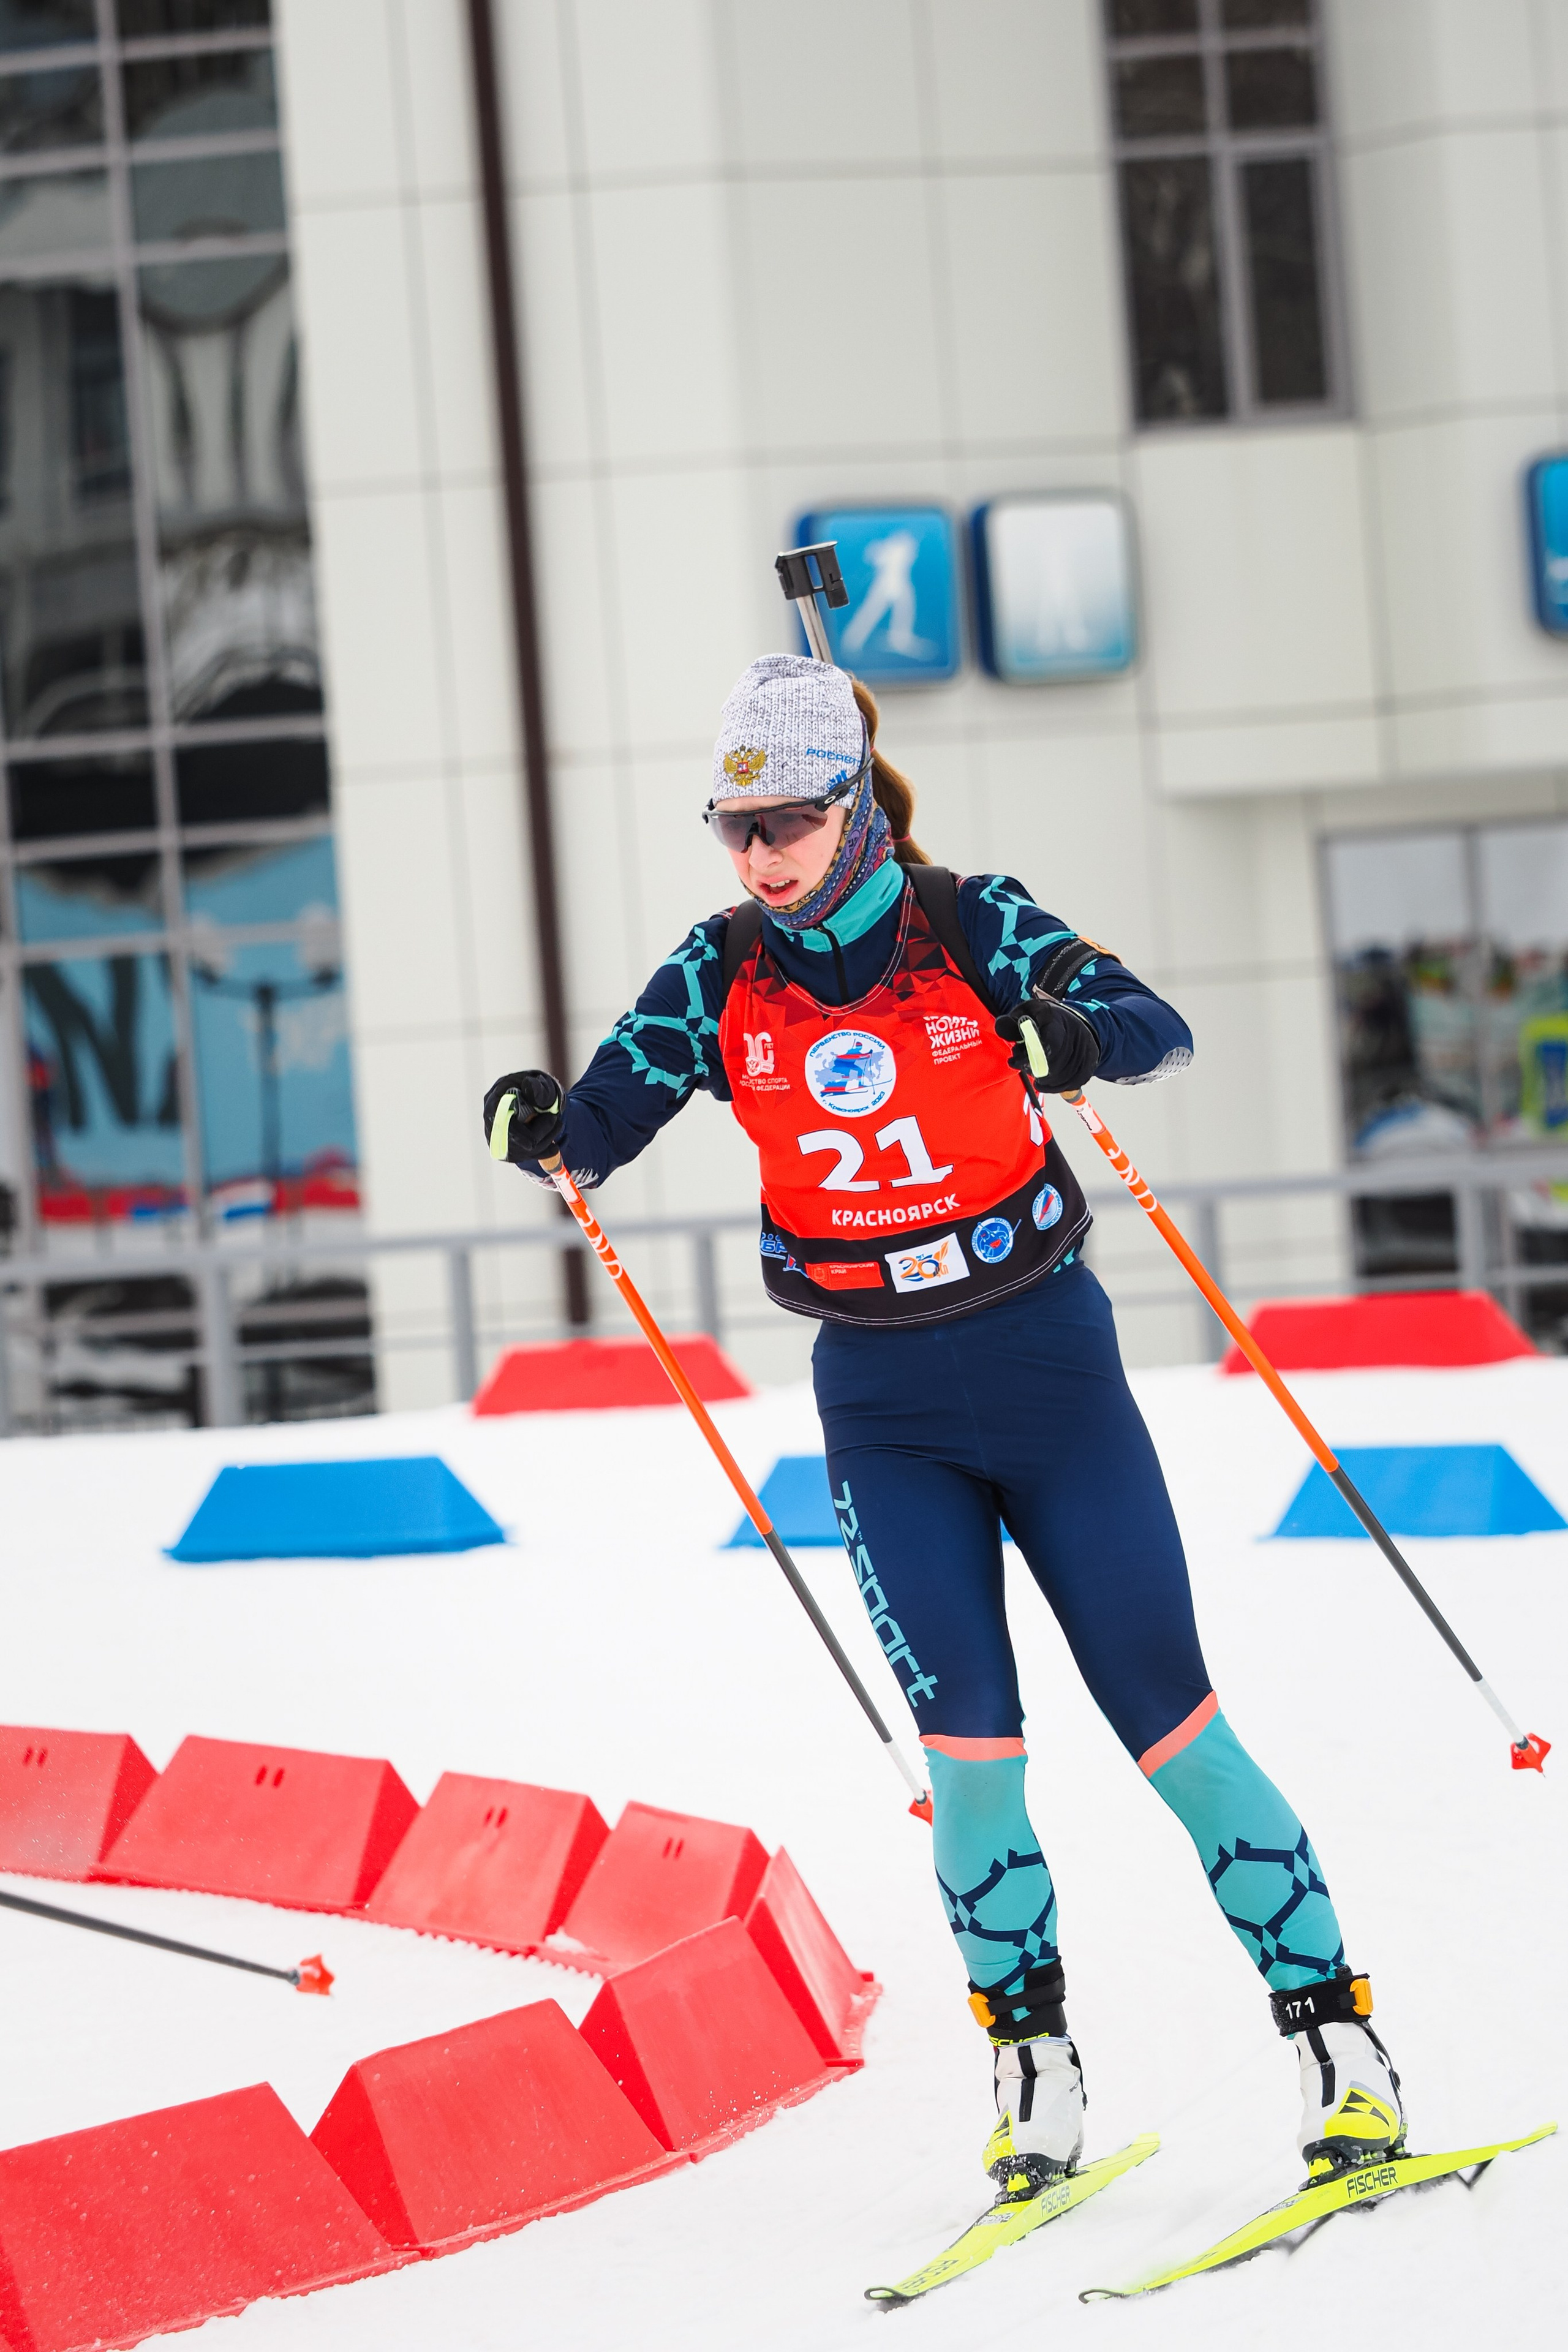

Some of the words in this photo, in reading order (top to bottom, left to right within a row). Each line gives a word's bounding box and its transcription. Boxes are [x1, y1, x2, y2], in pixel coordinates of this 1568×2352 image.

[810, 1031, 851, 1057] ПЕРВЕНСТВО
[853, 1032, 886, 1050] РОССИИ
[933, 1053, 961, 1065] ПРОЕКТ
[796, 1115, 954, 1193] 21
[832, 1193, 961, 1227] КРАСНОЯРСК
[1285, 1996, 1315, 2019] 171
[1346, 2166, 1398, 2198] FISCHER
[1041, 2185, 1071, 2218] FISCHER
